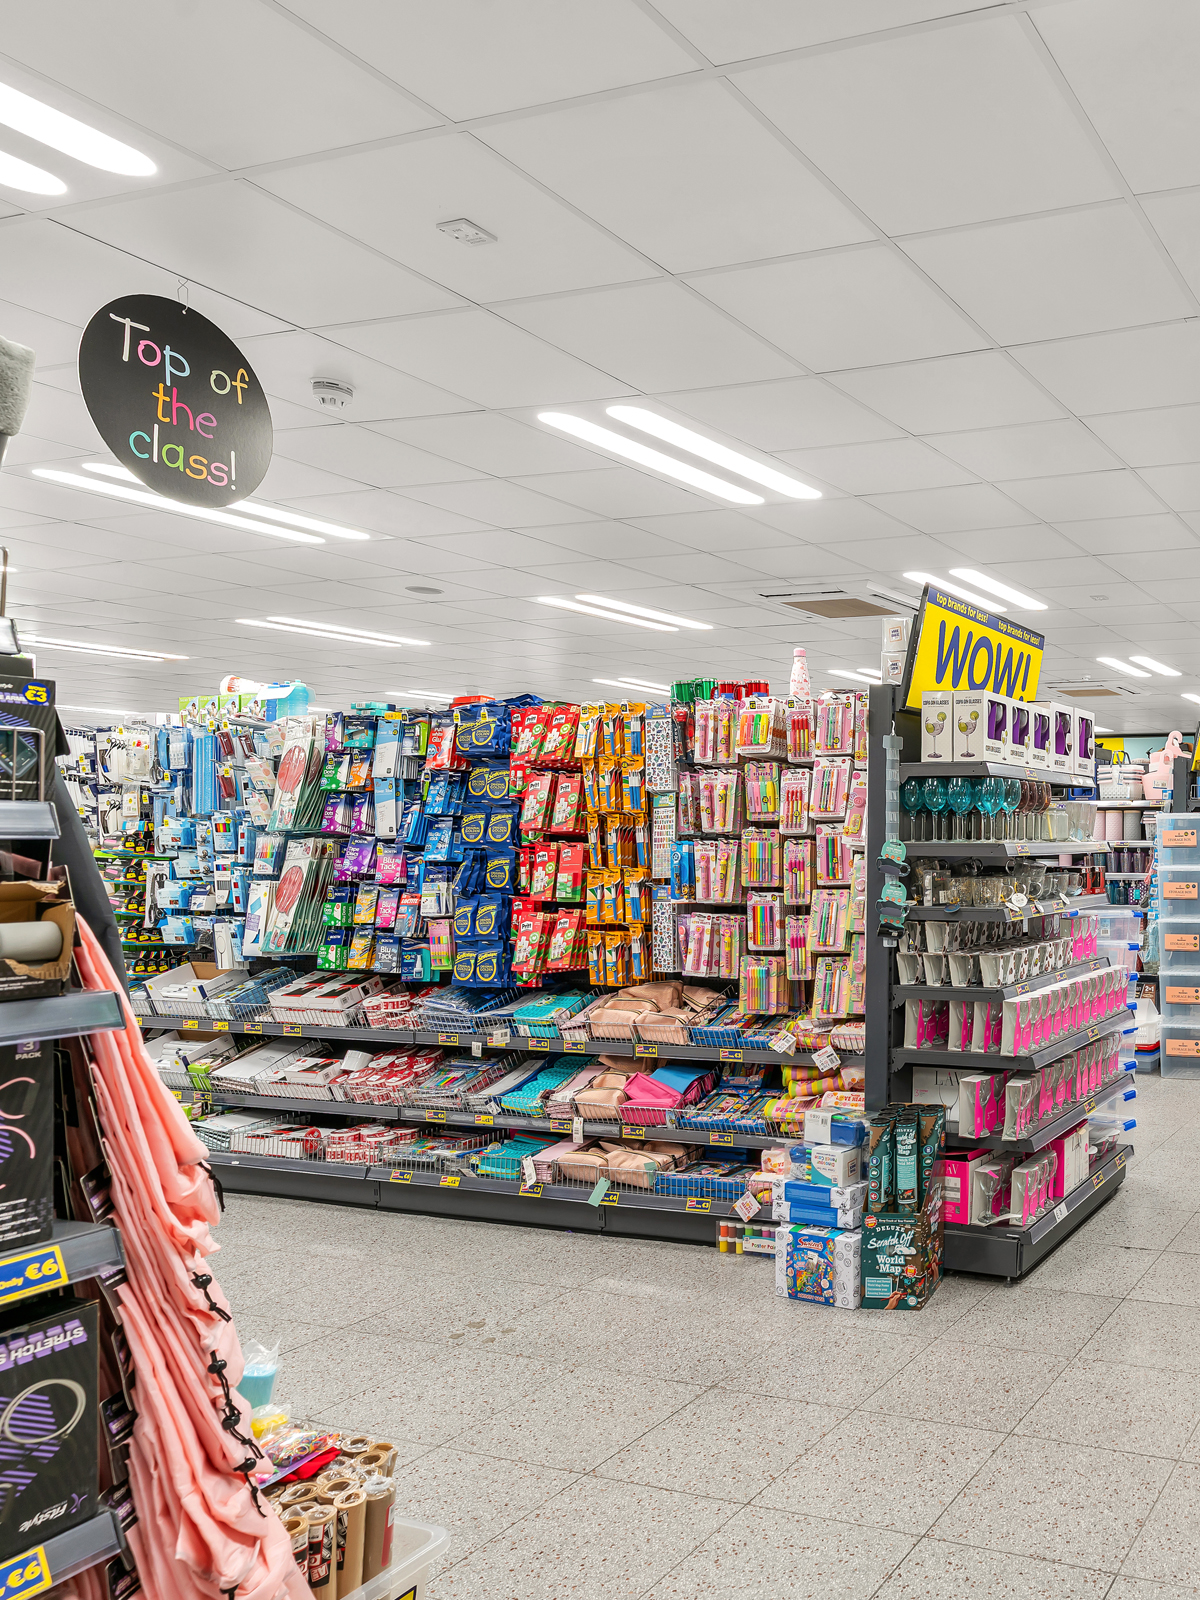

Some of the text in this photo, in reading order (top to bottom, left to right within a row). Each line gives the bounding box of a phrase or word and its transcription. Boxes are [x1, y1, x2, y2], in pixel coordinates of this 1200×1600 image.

[109, 312, 249, 404] Top of
[152, 382, 217, 439] the
[129, 423, 236, 490] class!
[936, 592, 989, 623] top brands for less!
[998, 620, 1007, 632] top
[1007, 623, 1023, 638] brands
[1030, 634, 1041, 646] less!
[935, 620, 1032, 702] WOW!
[25, 690, 47, 702] €3
[15, 1051, 42, 1060] PACK
[23, 1041, 34, 1050] 3
[867, 1230, 915, 1249] Scratch Off
[25, 1258, 58, 1280] €6
[876, 1255, 905, 1264] World
[879, 1264, 902, 1275] Map
[10, 1326, 84, 1361] STRETCH
[6, 1560, 42, 1588] €6
